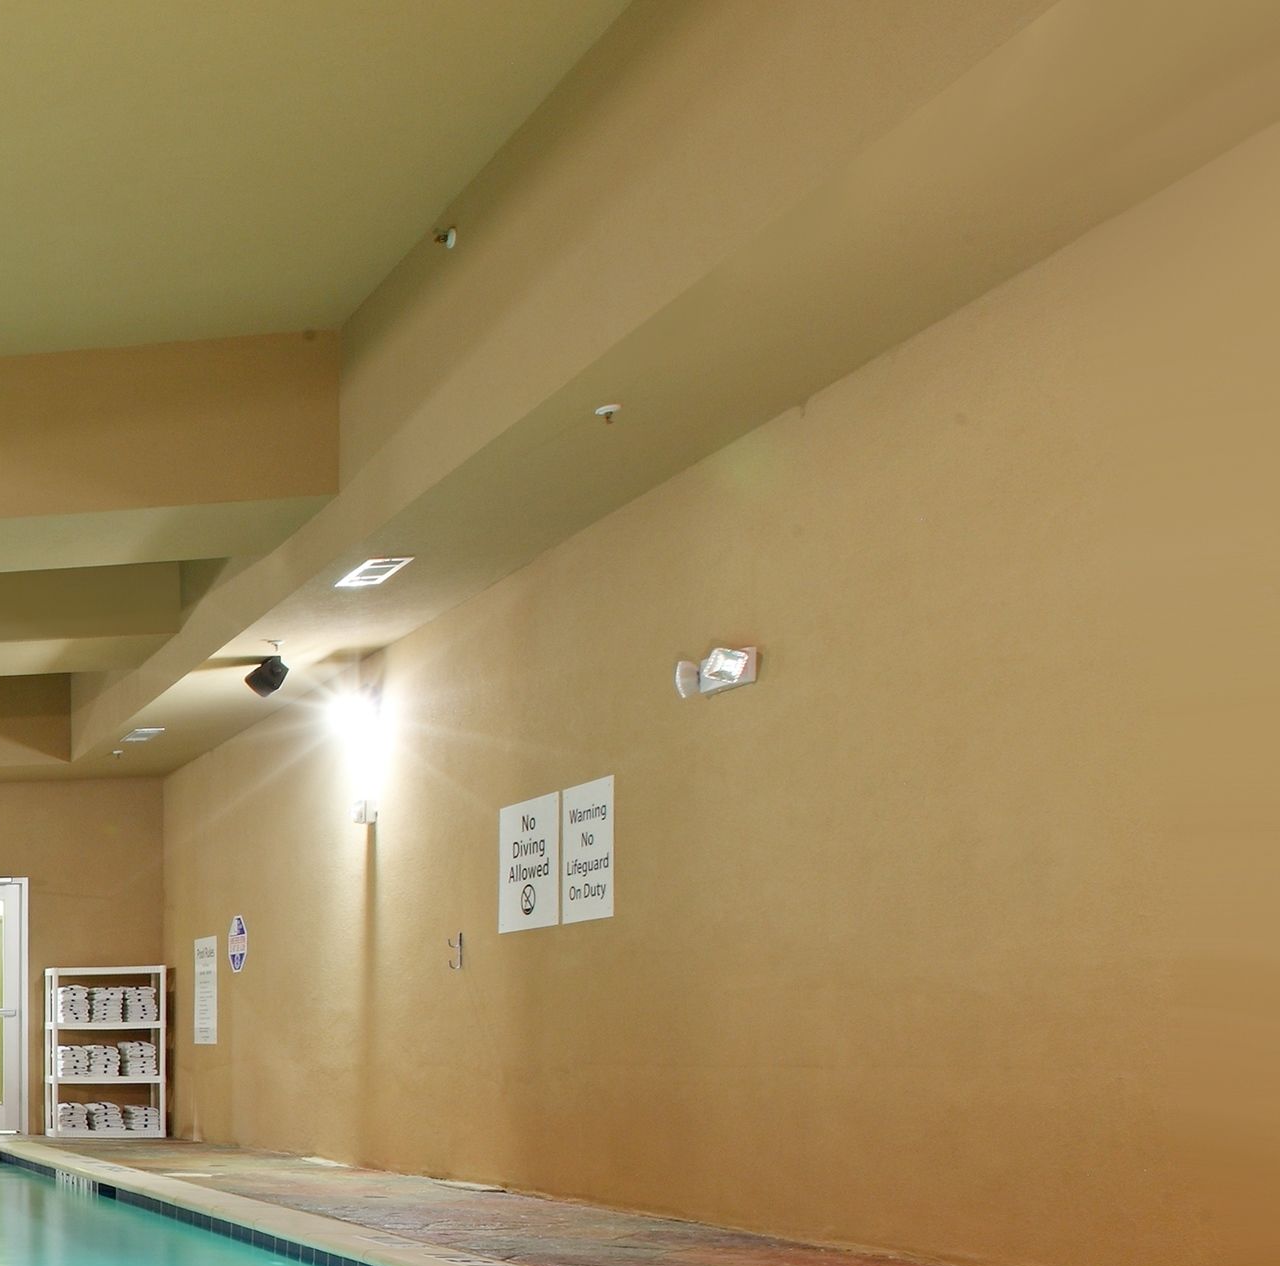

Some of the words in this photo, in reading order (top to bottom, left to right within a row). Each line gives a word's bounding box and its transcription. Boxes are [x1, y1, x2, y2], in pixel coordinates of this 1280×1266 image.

[521, 815, 536, 832] No
[569, 803, 607, 824] Warning
[512, 838, 546, 859] Diving
[581, 832, 594, 847] No
[508, 857, 550, 883] Allowed
[567, 852, 609, 877] Lifeguard
[569, 886, 582, 901] On
[584, 883, 606, 899] Duty
